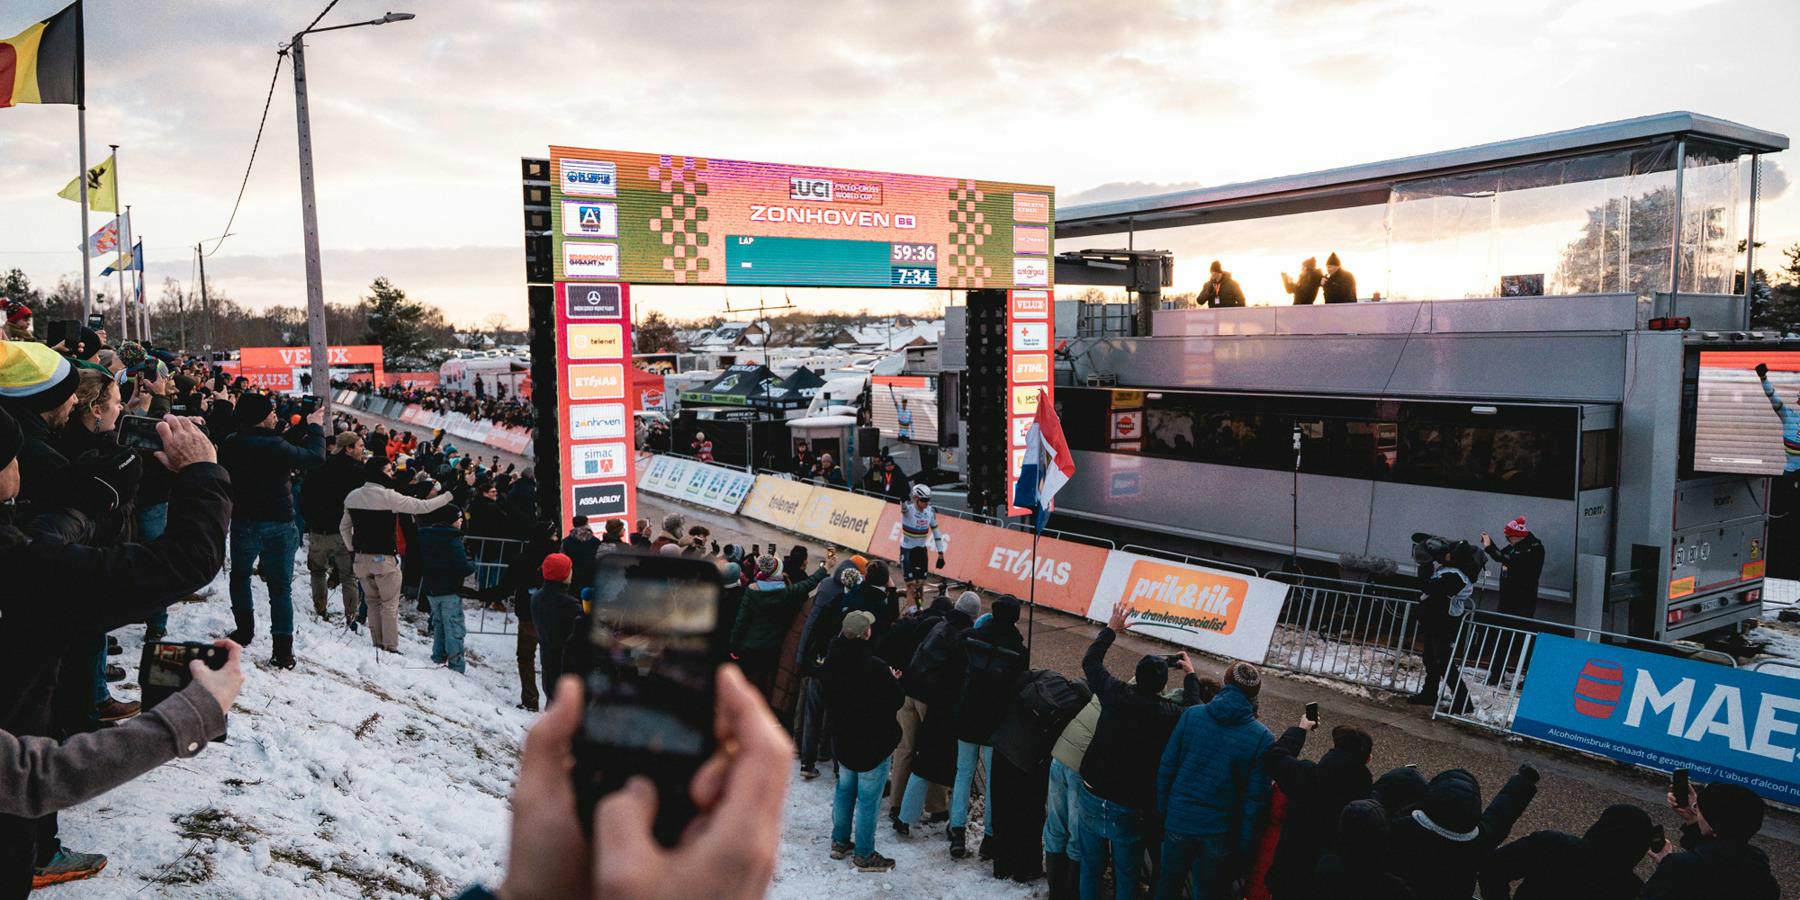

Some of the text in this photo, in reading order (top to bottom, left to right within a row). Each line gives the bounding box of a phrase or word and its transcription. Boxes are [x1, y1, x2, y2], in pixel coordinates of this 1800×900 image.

[797, 181, 830, 198] UCI
[834, 183, 879, 193] CYCLO-CROSS
[750, 205, 913, 227] ZONHOVEN BE
[739, 237, 754, 245] LAP
[893, 245, 935, 261] 59:36
[898, 269, 931, 285] 7:34
[1017, 300, 1043, 309] VELUX
[279, 349, 348, 365] VEX
[1016, 363, 1044, 372] STIHL
[584, 449, 613, 459] simac
[579, 494, 621, 506] ASSA ABLOY
[768, 494, 801, 516] telenet
[828, 510, 870, 535] telenet
[1128, 574, 1233, 617] prik&tik
[1141, 609, 1227, 631] drankenspecialist
[1622, 667, 1800, 763] MAE
[1547, 728, 1611, 750] Alcoholmisbruik
[1612, 743, 1645, 759] schaadt
[1646, 751, 1658, 762] de
[1658, 755, 1713, 775] gezondheid.
[1719, 769, 1749, 784] L'abus
[1750, 777, 1788, 793] d'alcool
